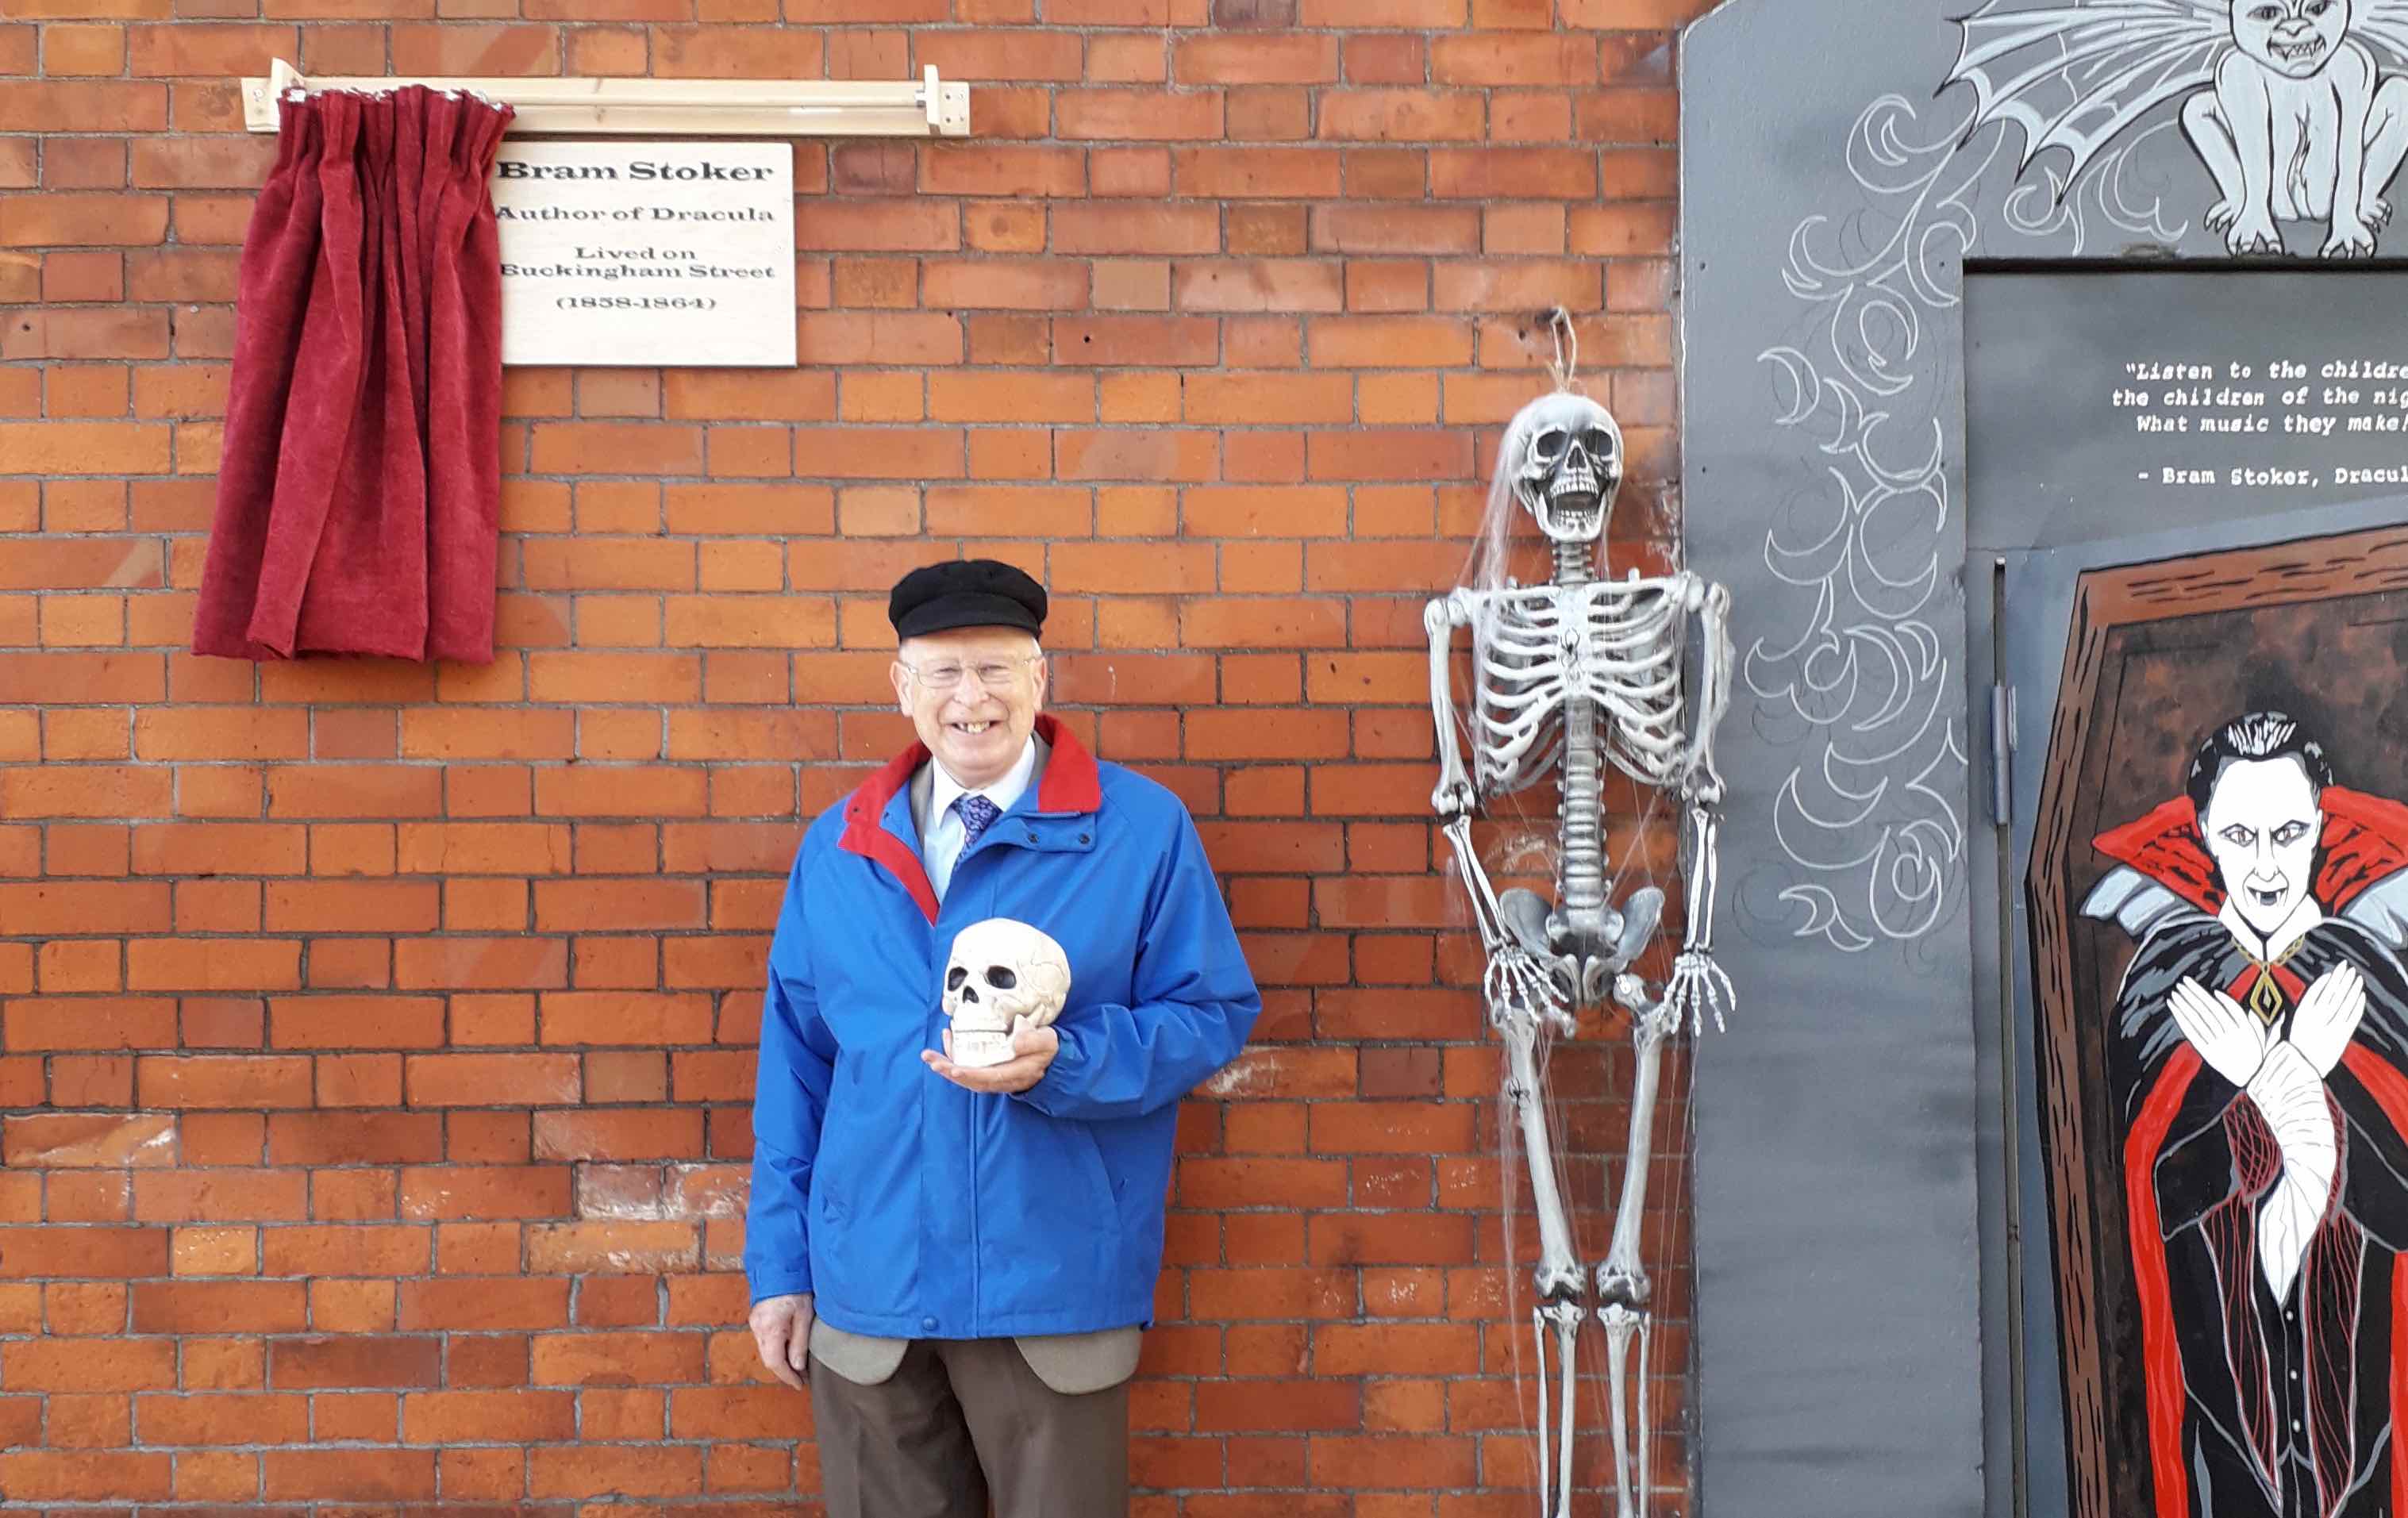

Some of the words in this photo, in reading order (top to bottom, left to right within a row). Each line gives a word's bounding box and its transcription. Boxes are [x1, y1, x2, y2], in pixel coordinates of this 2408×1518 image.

[498, 161, 618, 181] Bram
[629, 161, 775, 181] Stoker
[496, 206, 606, 221] Author
[612, 206, 644, 221] of
[652, 207, 774, 222] Dracula
[575, 247, 656, 260] Lived
[662, 250, 696, 260] on
[502, 264, 681, 280] Buckingham
[689, 265, 775, 279] Street
[556, 297, 717, 310] (1858-1864)
[2125, 362, 2213, 381] "Listen
[2229, 361, 2252, 379] to
[2268, 360, 2307, 379] the
[2112, 389, 2149, 407] the
[2164, 387, 2264, 406] children
[2281, 386, 2310, 405] of
[2322, 386, 2360, 405] the
[2137, 415, 2188, 432] What
[2199, 413, 2269, 432] music
[2283, 414, 2337, 436] they
[2162, 467, 2217, 485] Bram
[2231, 467, 2319, 488] Stoker,
